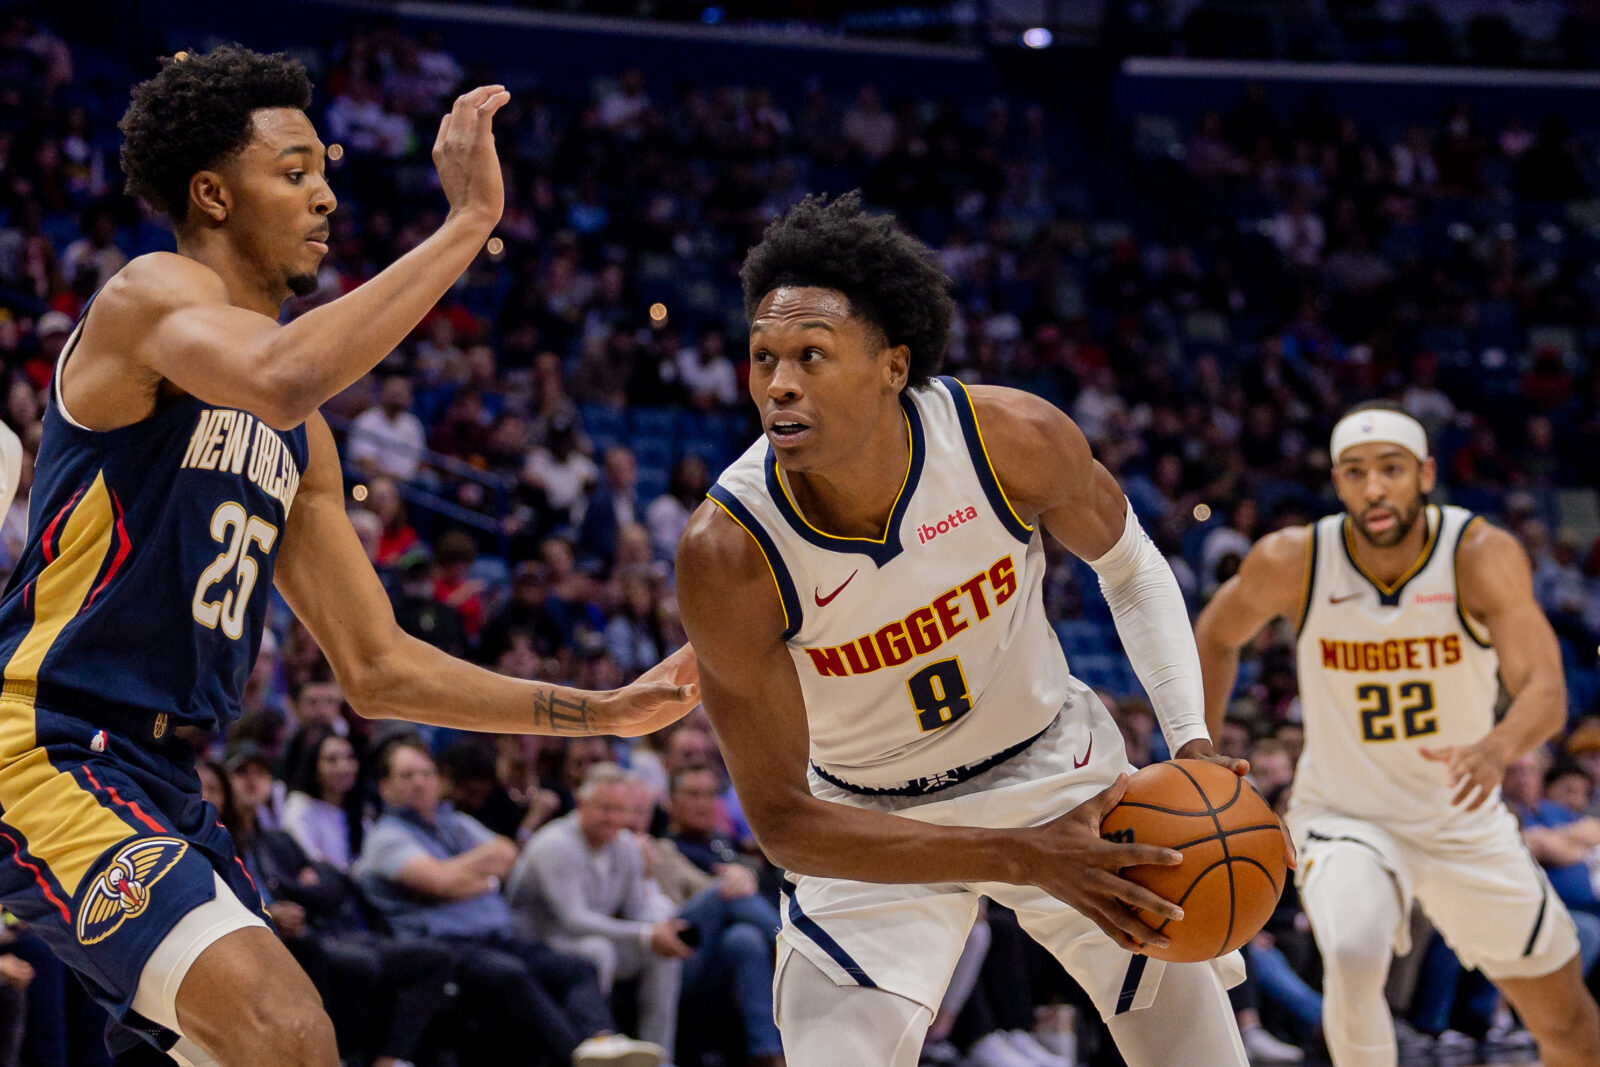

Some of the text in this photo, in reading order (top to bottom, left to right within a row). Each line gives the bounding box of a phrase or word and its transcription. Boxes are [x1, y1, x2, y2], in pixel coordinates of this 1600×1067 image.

[180, 409, 253, 474] NEW
[916, 505, 978, 545] ibotta
[192, 500, 278, 640] 25
[803, 553, 1018, 677] NUGGETS
[1318, 632, 1463, 673] NUGGETS
[905, 655, 974, 733] 8
[1355, 679, 1440, 743] 22
